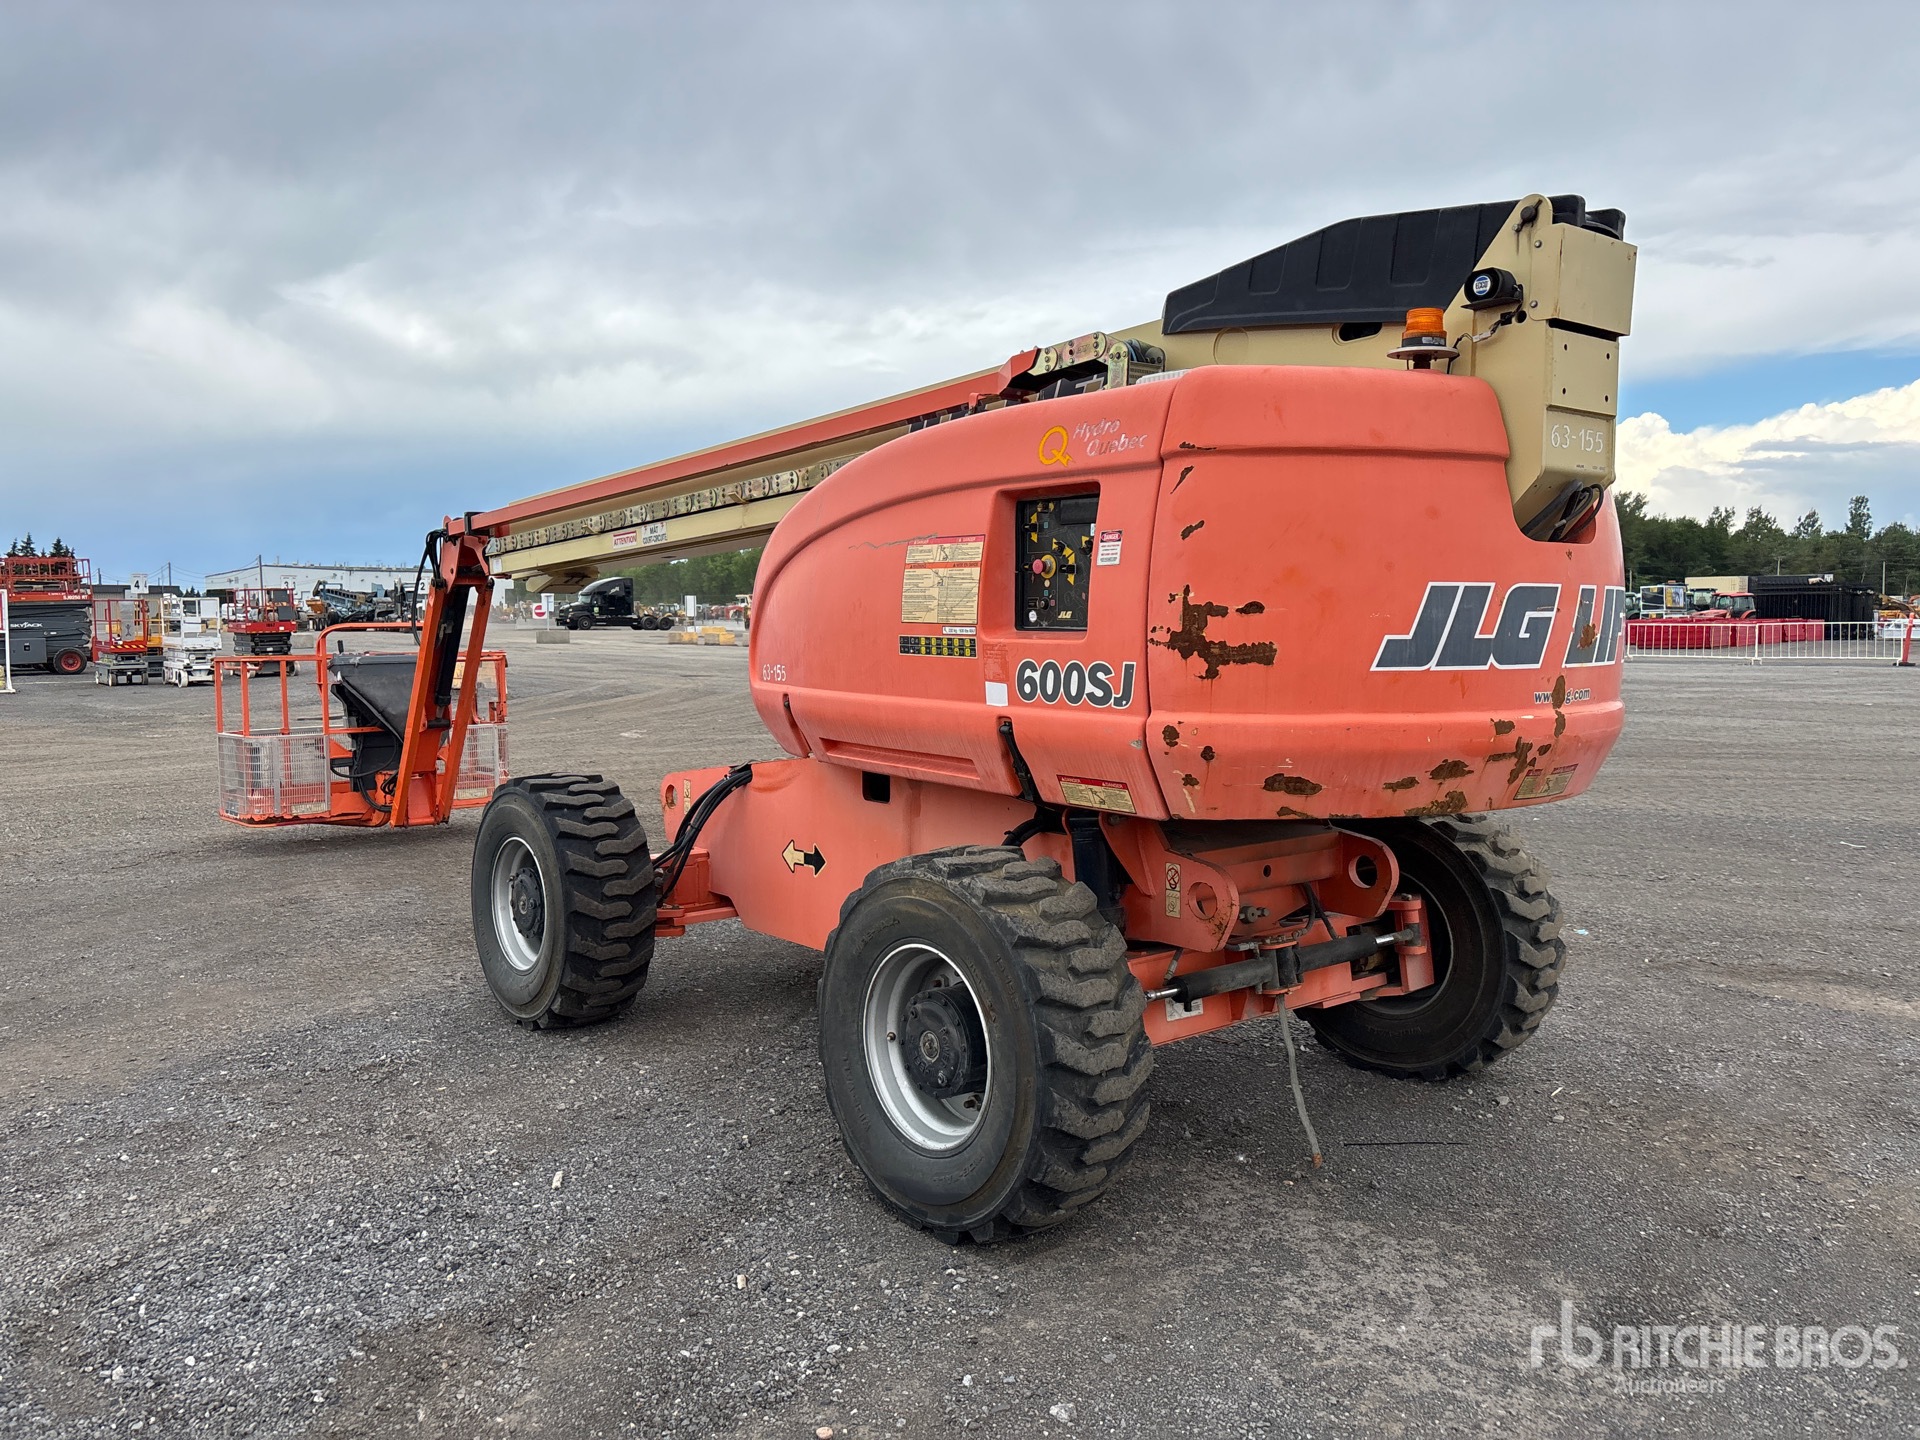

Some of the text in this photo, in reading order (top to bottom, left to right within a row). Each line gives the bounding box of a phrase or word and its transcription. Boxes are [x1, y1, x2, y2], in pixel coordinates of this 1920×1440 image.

[1073, 418, 1121, 443] Hydro
[1551, 423, 1604, 453] 63-155
[1086, 433, 1148, 457] Quebec
[613, 532, 637, 546] ATTENTION
[134, 579, 141, 590] 4
[10, 621, 44, 629] SKYJACK
[1058, 611, 1073, 619] JLG
[1369, 581, 1562, 672] JLG
[762, 663, 787, 682] 63-155
[1015, 658, 1137, 710] 600SJ
